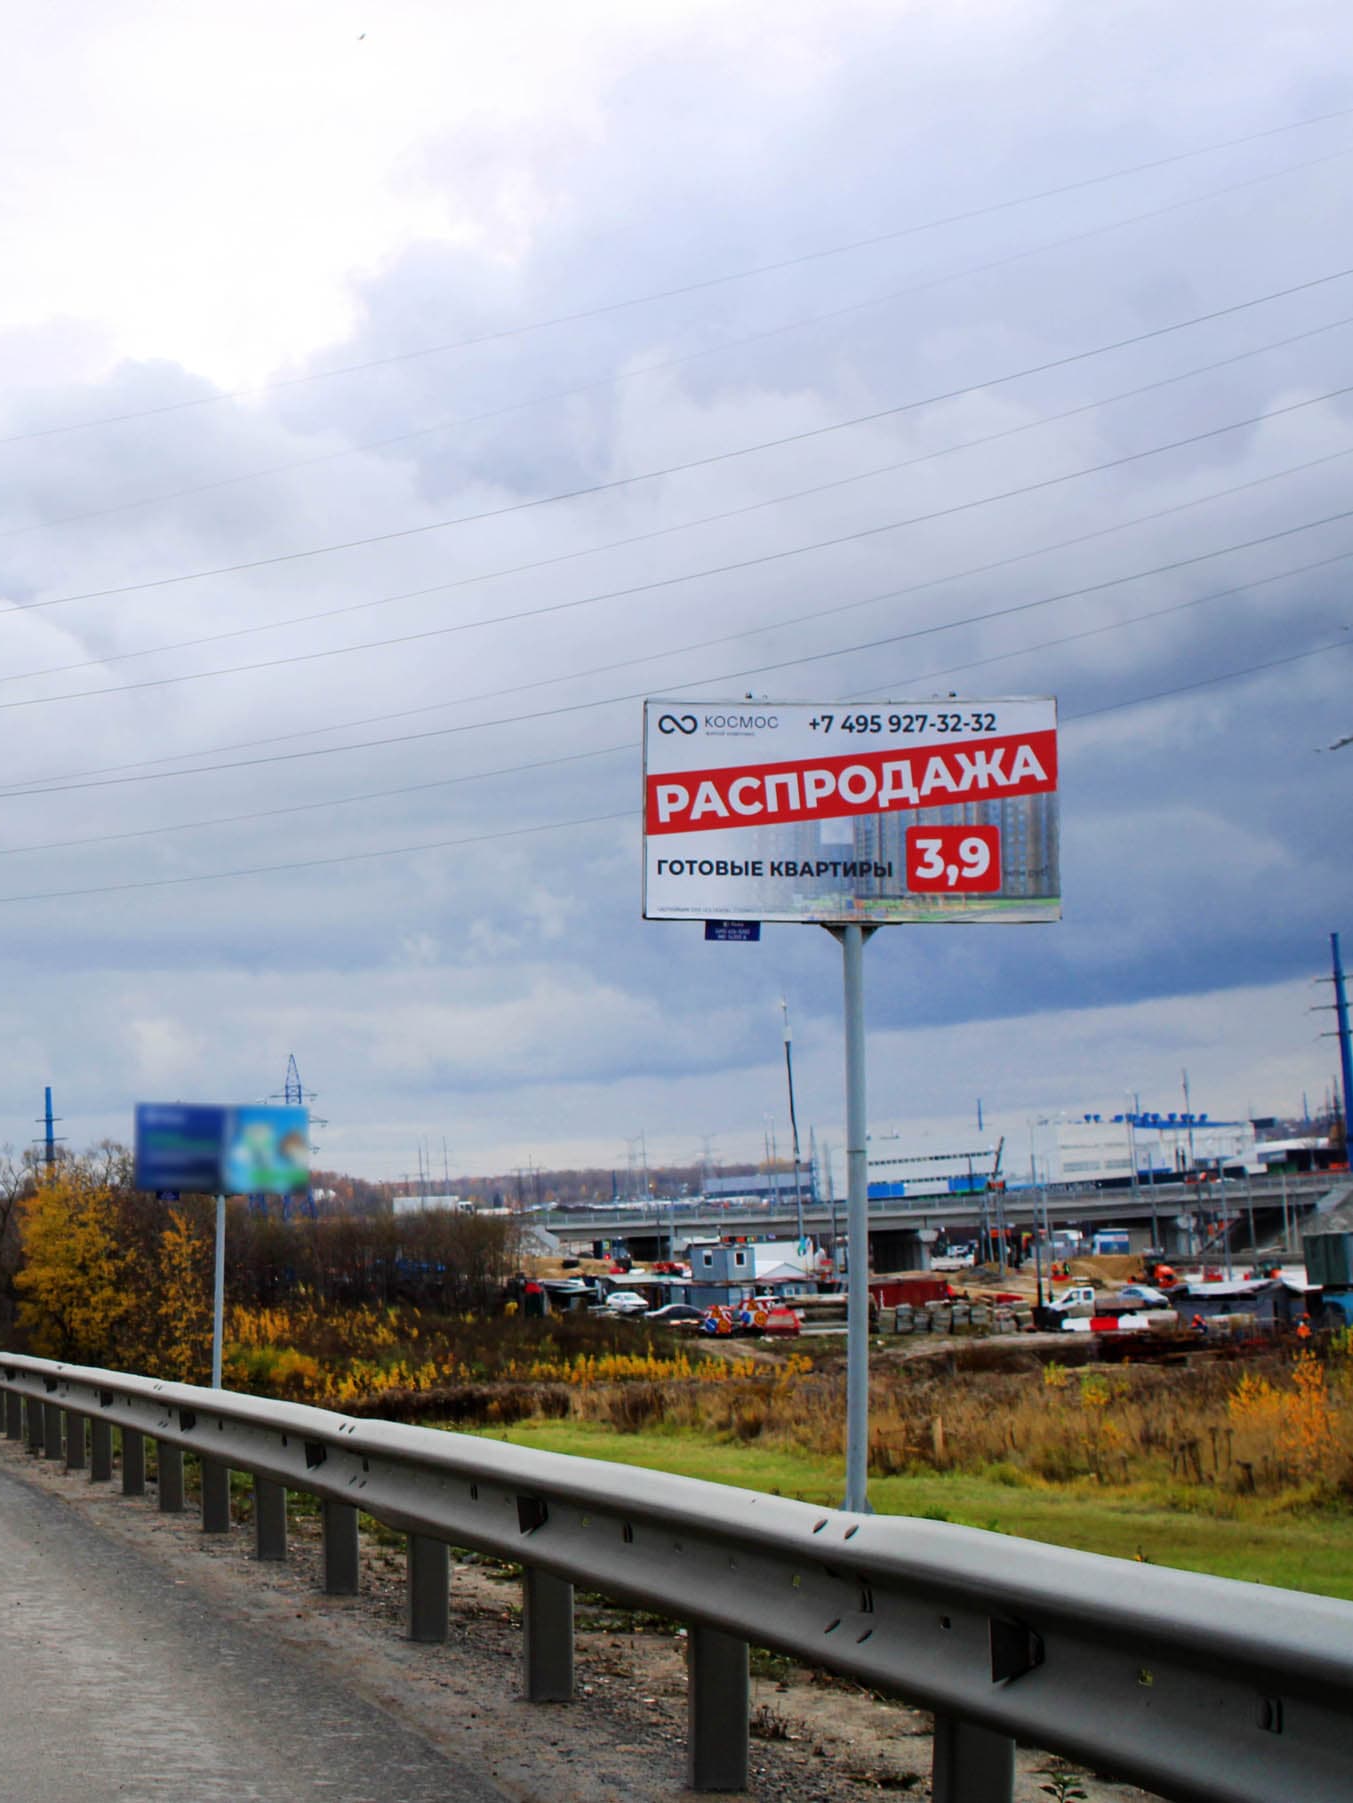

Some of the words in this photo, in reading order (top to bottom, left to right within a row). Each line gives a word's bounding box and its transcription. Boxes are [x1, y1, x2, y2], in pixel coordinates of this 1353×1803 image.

[704, 715, 779, 729] КОСМОС
[809, 714, 834, 733] +7
[840, 714, 882, 733] 495
[888, 713, 997, 733] 927-32-32
[656, 744, 1048, 824] РАСПРОДАЖА
[657, 858, 763, 877] ГОТОВЫЕ
[770, 861, 893, 878] КВАРТИРЫ
[914, 837, 991, 886] 3,9
